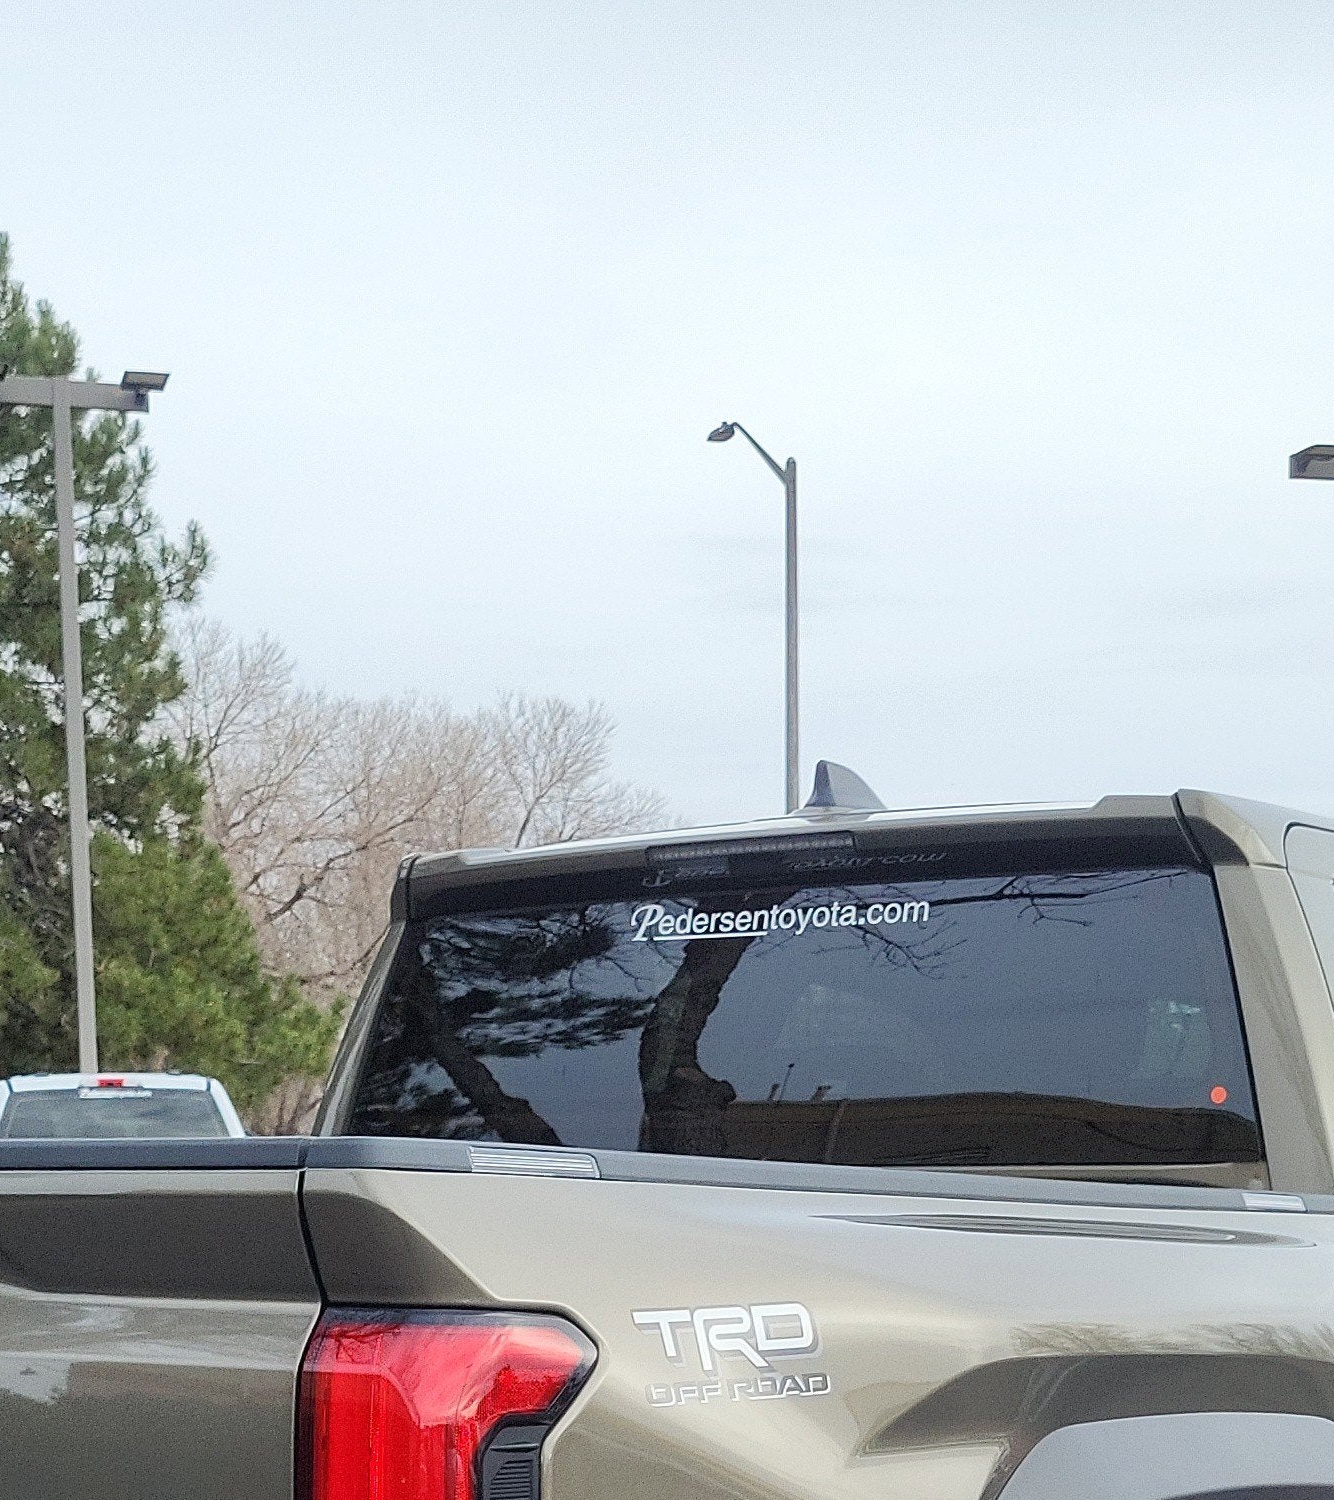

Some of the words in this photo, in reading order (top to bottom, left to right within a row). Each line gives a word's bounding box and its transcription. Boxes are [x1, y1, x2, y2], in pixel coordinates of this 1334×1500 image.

[631, 901, 930, 941] Pedersentoyota.com
[631, 1302, 820, 1376] TRD
[645, 1376, 726, 1408] OFF
[726, 1372, 832, 1403] ROAD
